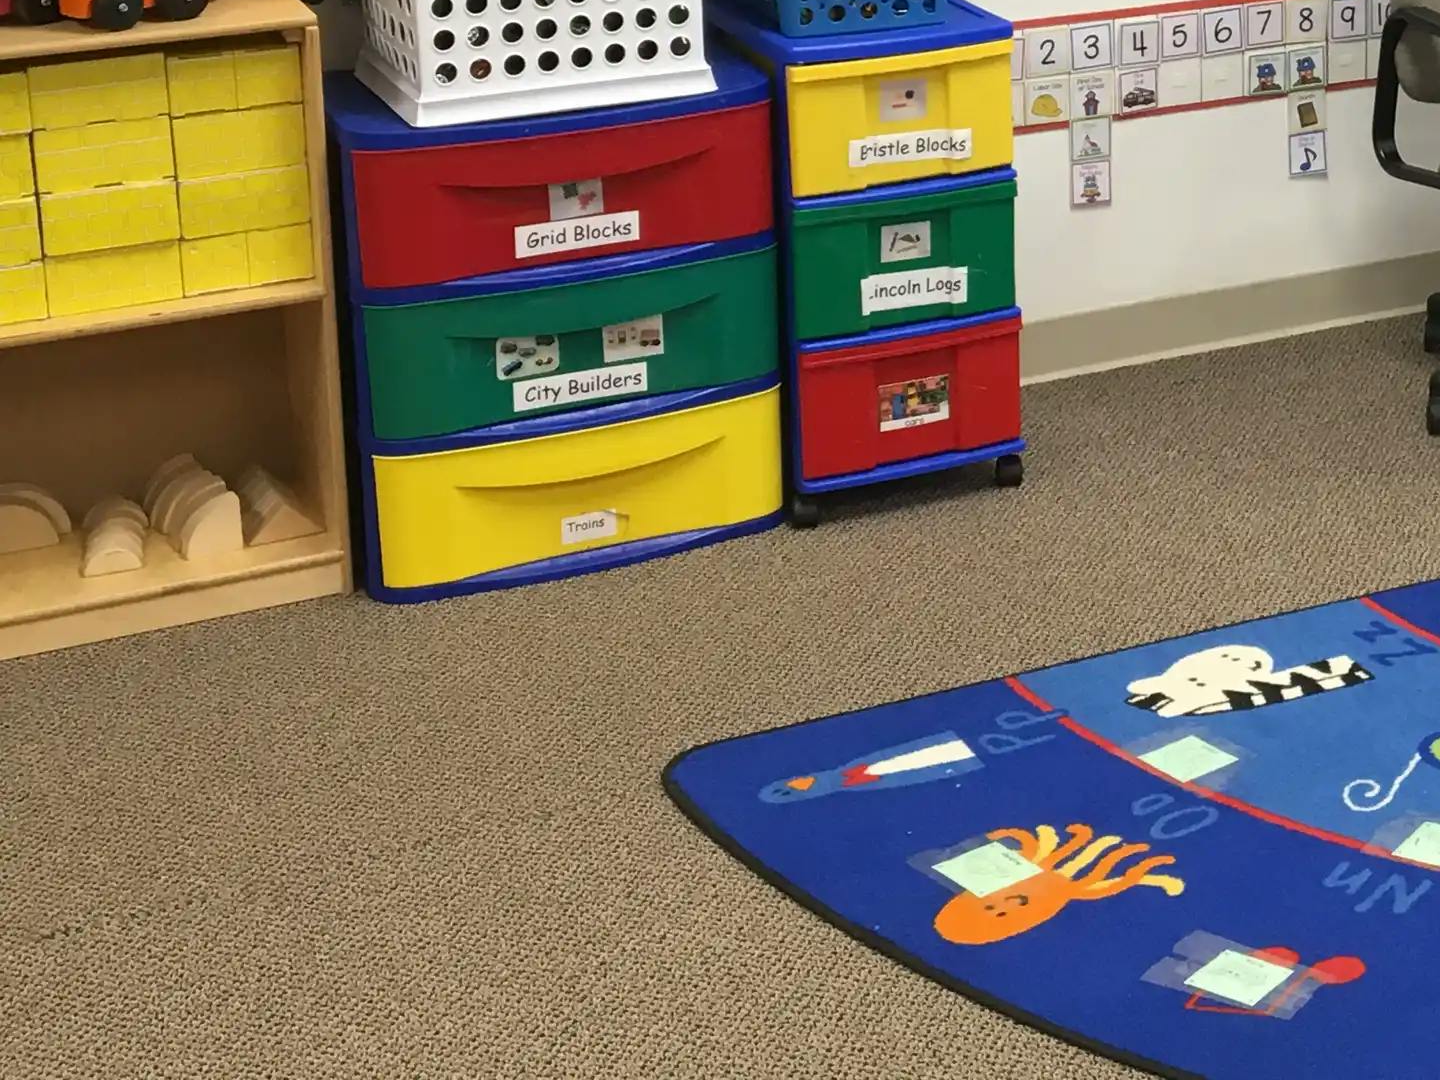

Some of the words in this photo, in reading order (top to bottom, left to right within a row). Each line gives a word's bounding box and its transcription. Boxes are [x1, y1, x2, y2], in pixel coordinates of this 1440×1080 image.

[1039, 39, 1055, 65] 2
[1083, 35, 1099, 60] 3
[1132, 30, 1147, 57] 4
[1172, 24, 1188, 48] 5
[1214, 17, 1233, 43] 6
[1256, 10, 1272, 35] 7
[1299, 7, 1314, 32] 8
[1340, 6, 1355, 31] 9
[916, 136, 966, 154] Blocks
[527, 228, 567, 249] Grid
[573, 220, 632, 241] Blocks
[926, 277, 962, 295] Logs
[525, 384, 561, 403] City
[568, 372, 642, 395] Builders
[567, 518, 605, 533] Trains
[1131, 793, 1220, 840] Oo
[1321, 861, 1433, 915] Nn
